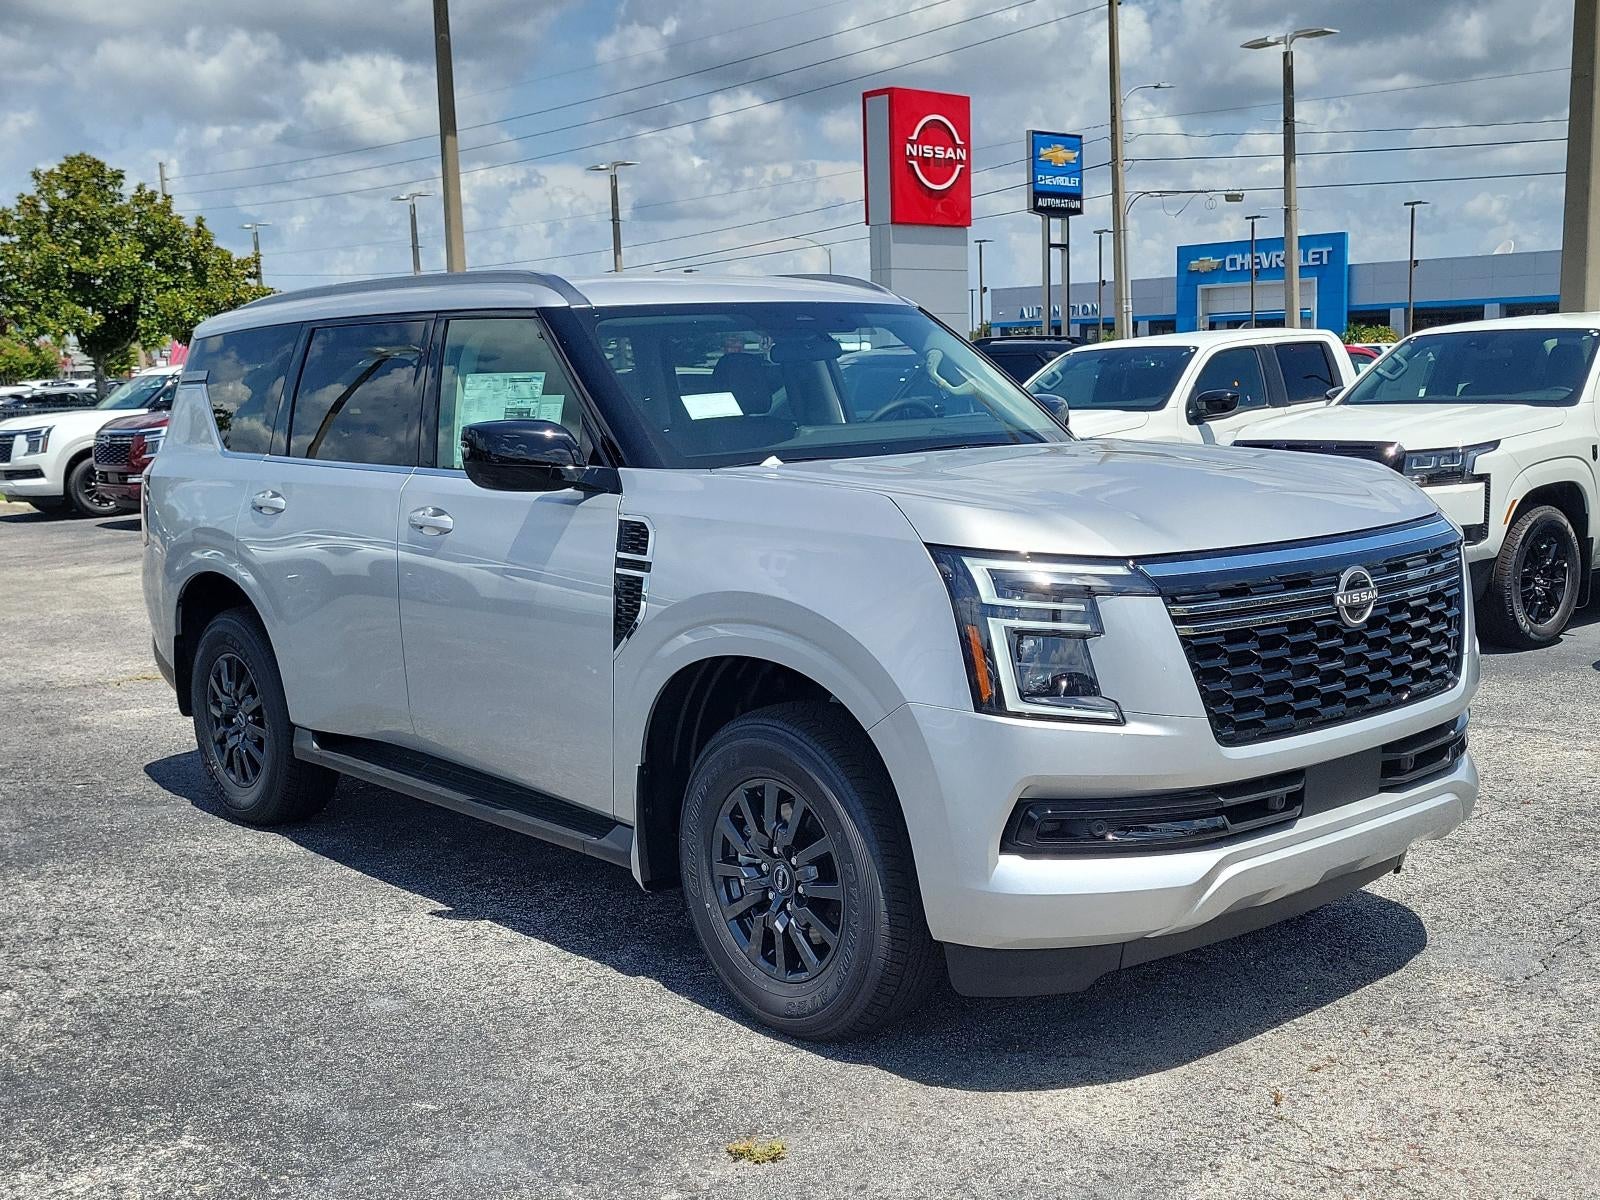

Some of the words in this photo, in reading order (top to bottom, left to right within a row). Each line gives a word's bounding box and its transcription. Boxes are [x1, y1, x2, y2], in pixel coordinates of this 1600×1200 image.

[906, 143, 967, 161] NISSAN
[1037, 174, 1080, 187] CHEVROLET
[1037, 197, 1081, 209] AUTONATION
[1225, 247, 1333, 272] CHEVRLET
[1019, 303, 1100, 319] AUTNTION
[1336, 588, 1378, 605] NISSAN
